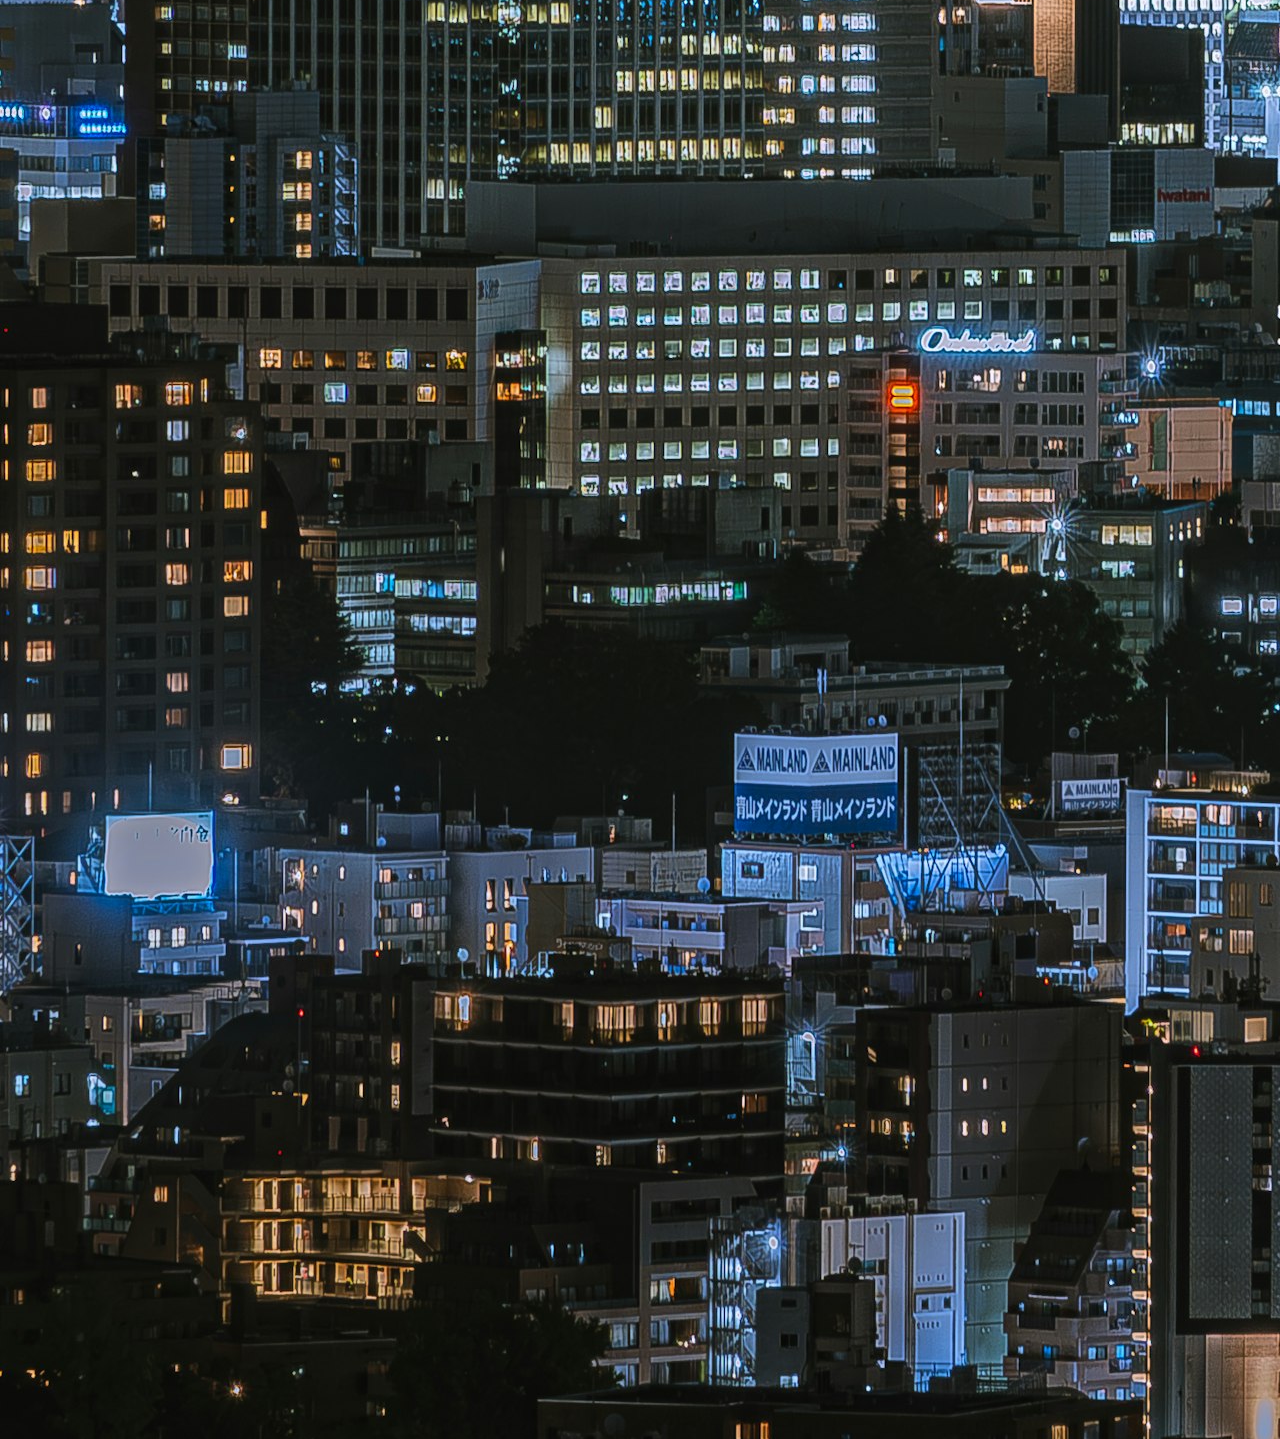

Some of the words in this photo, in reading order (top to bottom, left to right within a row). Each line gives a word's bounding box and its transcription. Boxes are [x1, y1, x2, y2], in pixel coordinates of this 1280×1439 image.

[1157, 188, 1210, 203] Iwatani
[756, 746, 808, 774] MAINLAND
[832, 745, 896, 772] MAINLAND
[1075, 782, 1118, 796] MAINLAND
[736, 795, 808, 822] 青山メインランド
[811, 795, 896, 822] 青山メインランド
